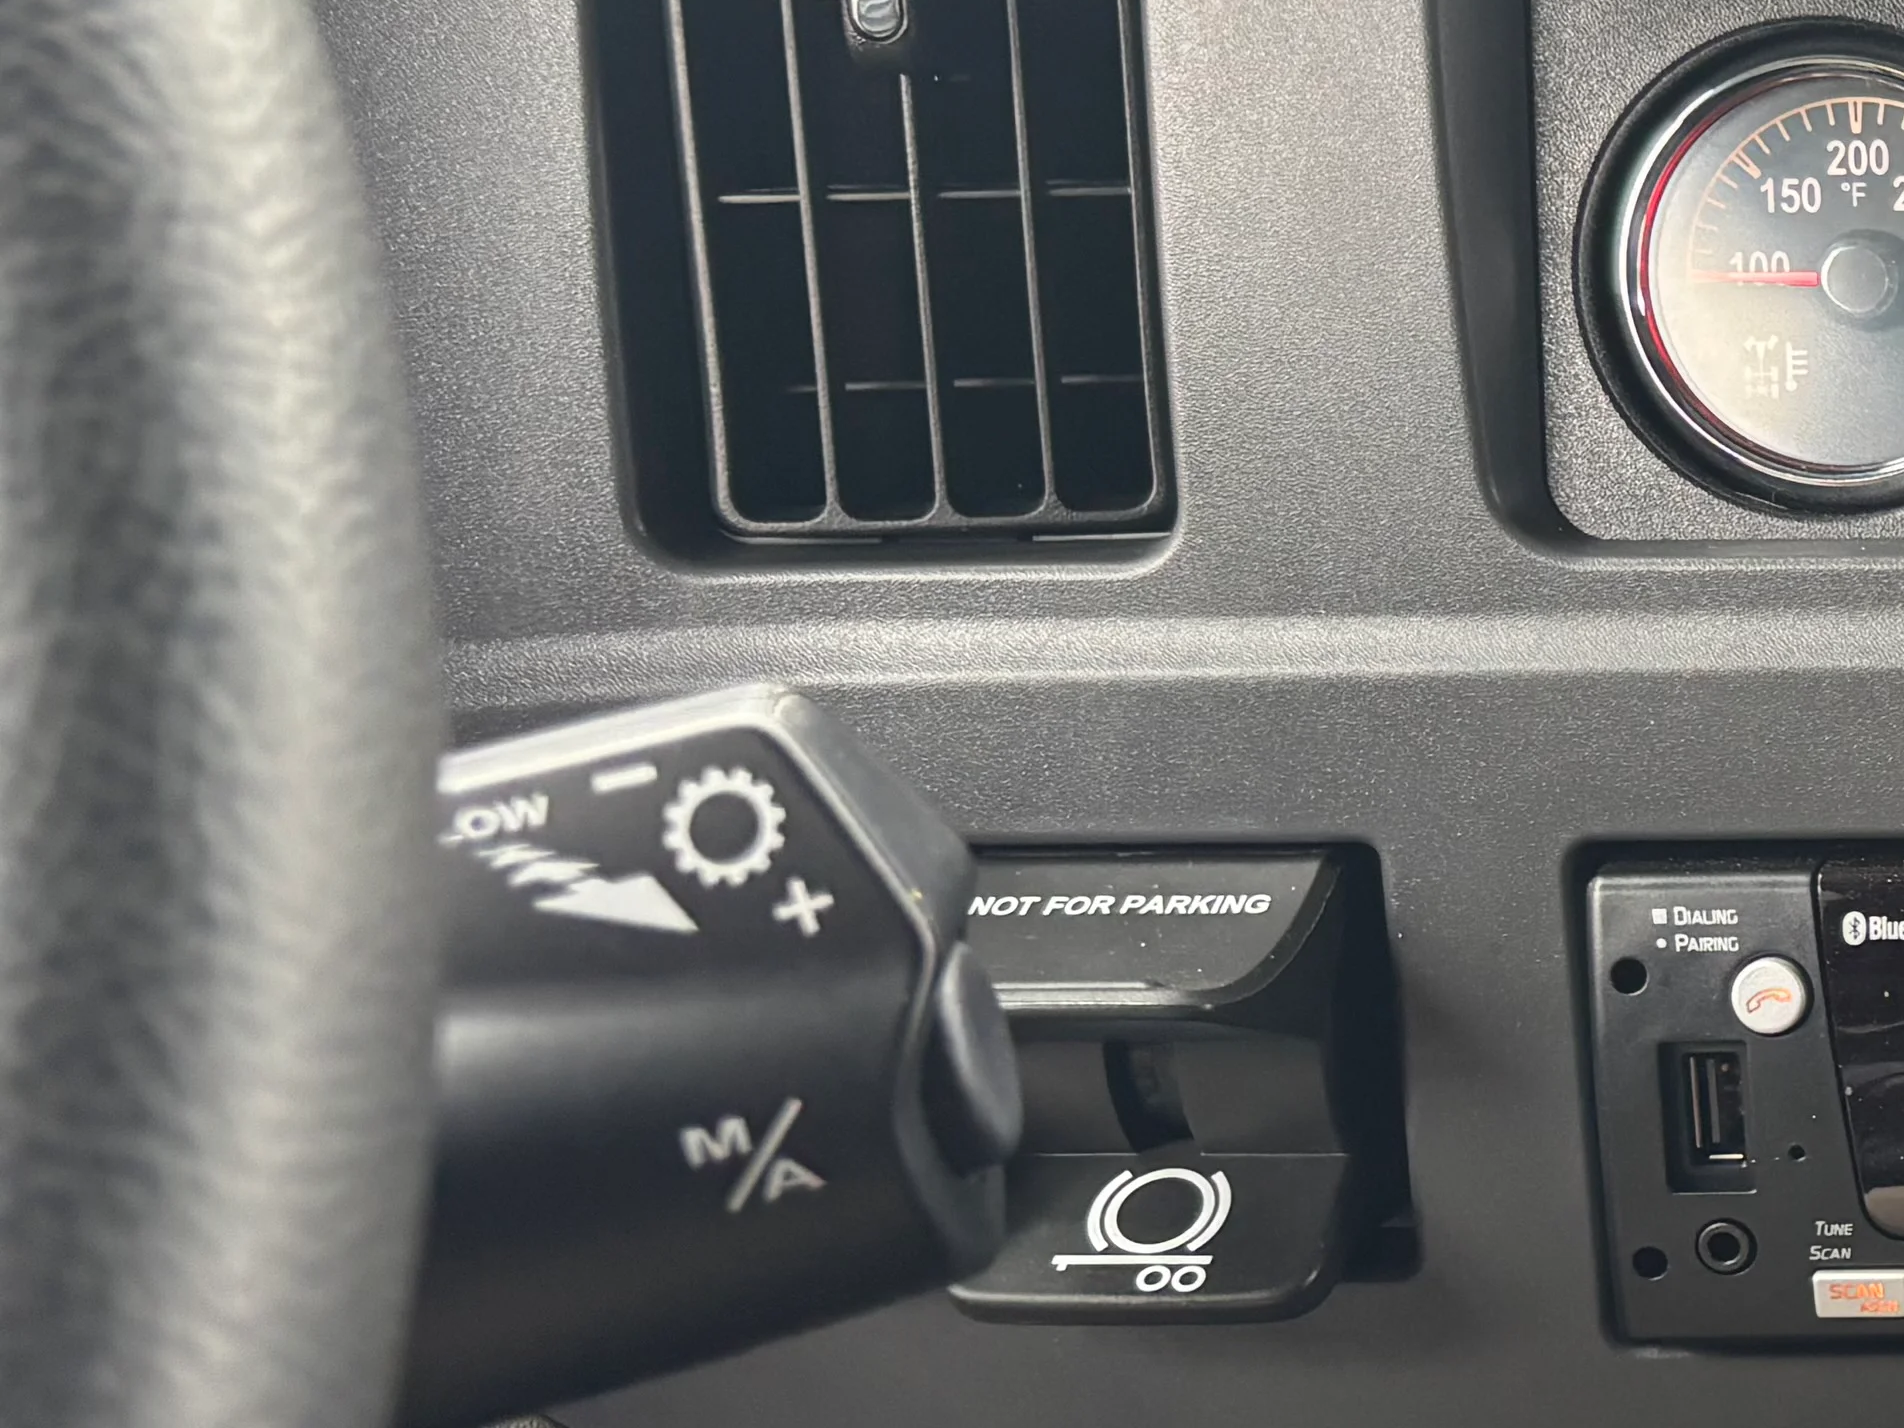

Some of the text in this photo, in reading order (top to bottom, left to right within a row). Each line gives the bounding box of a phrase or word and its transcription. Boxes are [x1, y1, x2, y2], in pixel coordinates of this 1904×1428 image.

[1826, 139, 1889, 176] 200
[1760, 177, 1822, 214] 150
[967, 894, 1272, 917] NOT FOR PARKING
[1828, 1282, 1885, 1300] SCAN
